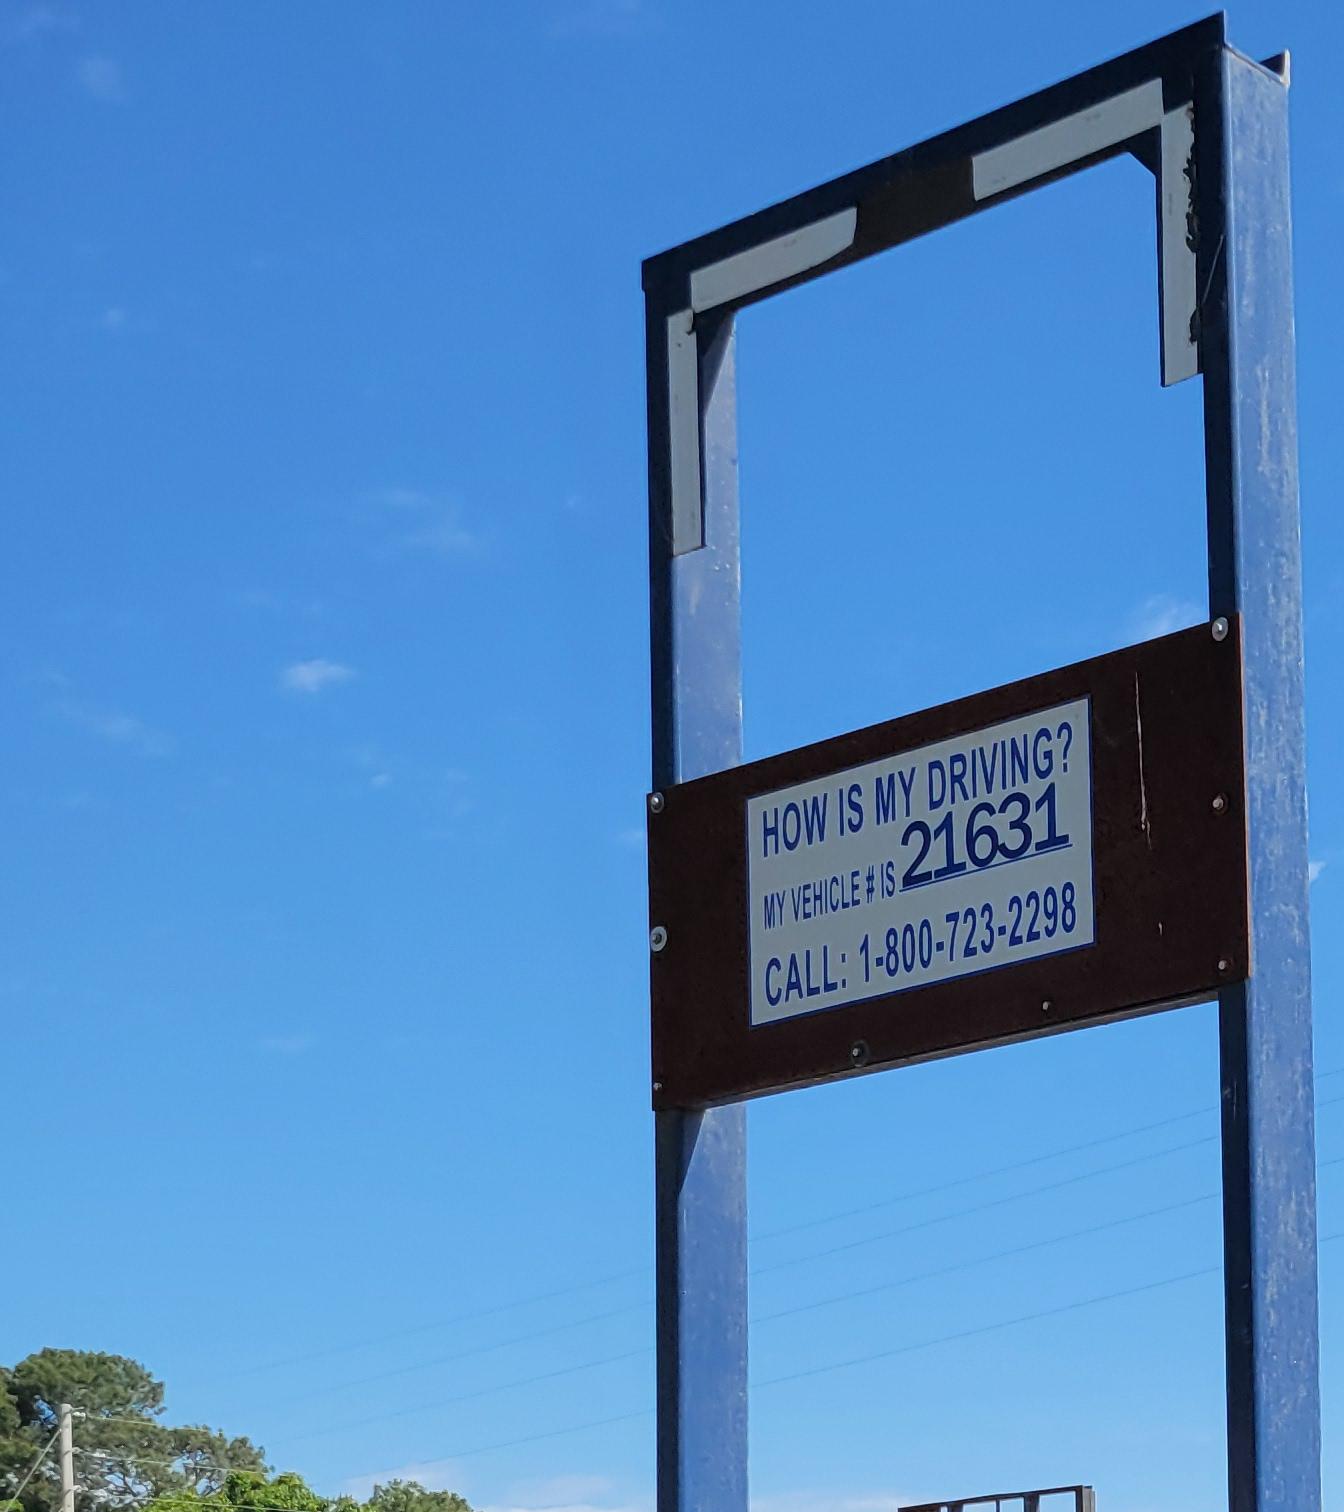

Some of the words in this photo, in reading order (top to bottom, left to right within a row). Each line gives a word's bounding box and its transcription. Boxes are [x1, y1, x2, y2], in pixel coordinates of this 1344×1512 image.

[762, 792, 828, 858] HOW
[838, 783, 864, 837] IS
[875, 766, 916, 826] MY
[927, 721, 1073, 811] DRIVING?
[763, 889, 787, 930] MY
[790, 869, 861, 923] VEHICLE
[865, 864, 876, 903] #
[880, 860, 896, 899] IS
[900, 781, 1070, 888] 21631
[764, 944, 847, 1007] CALL:
[858, 881, 1077, 983] 1-800-723-2298
